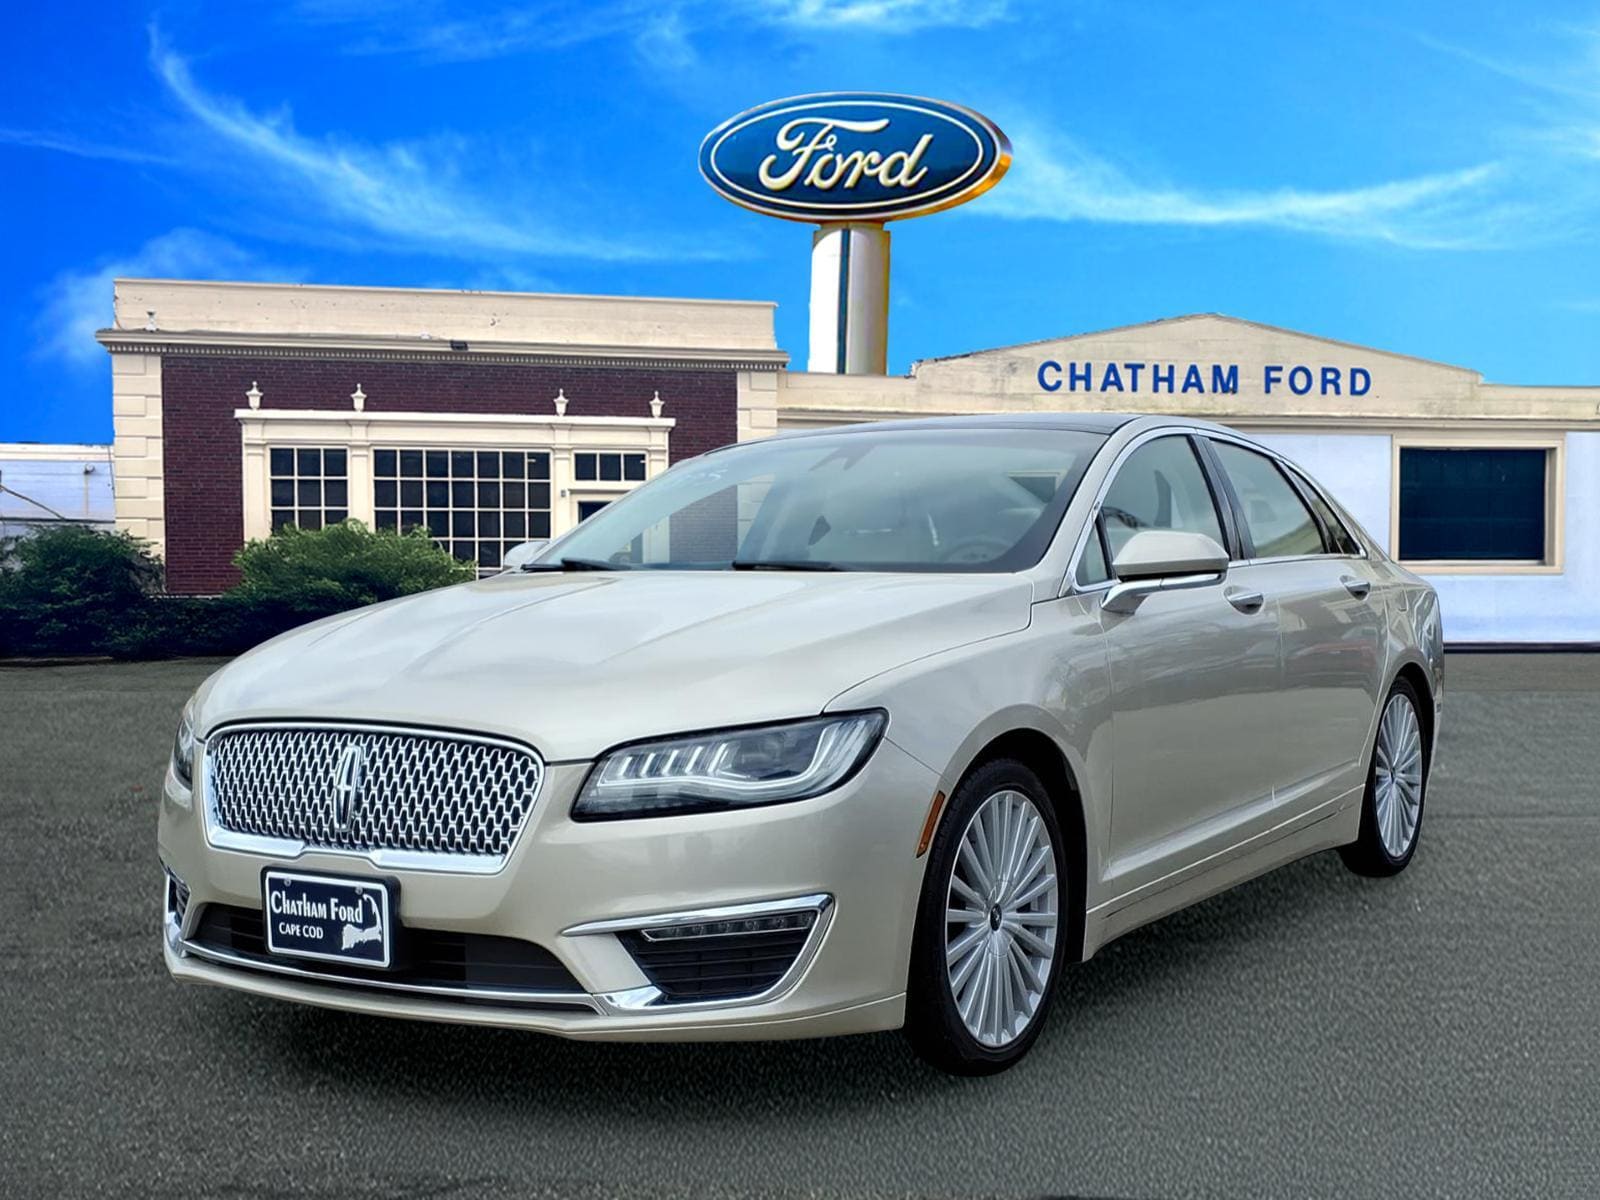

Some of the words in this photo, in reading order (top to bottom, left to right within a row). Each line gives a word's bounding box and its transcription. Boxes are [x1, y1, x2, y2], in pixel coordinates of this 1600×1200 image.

[758, 117, 934, 190] Ford
[1037, 360, 1238, 394] CHATHAM
[1264, 365, 1372, 396] FORD
[279, 921, 301, 937] CAPE
[302, 926, 324, 940] COD
